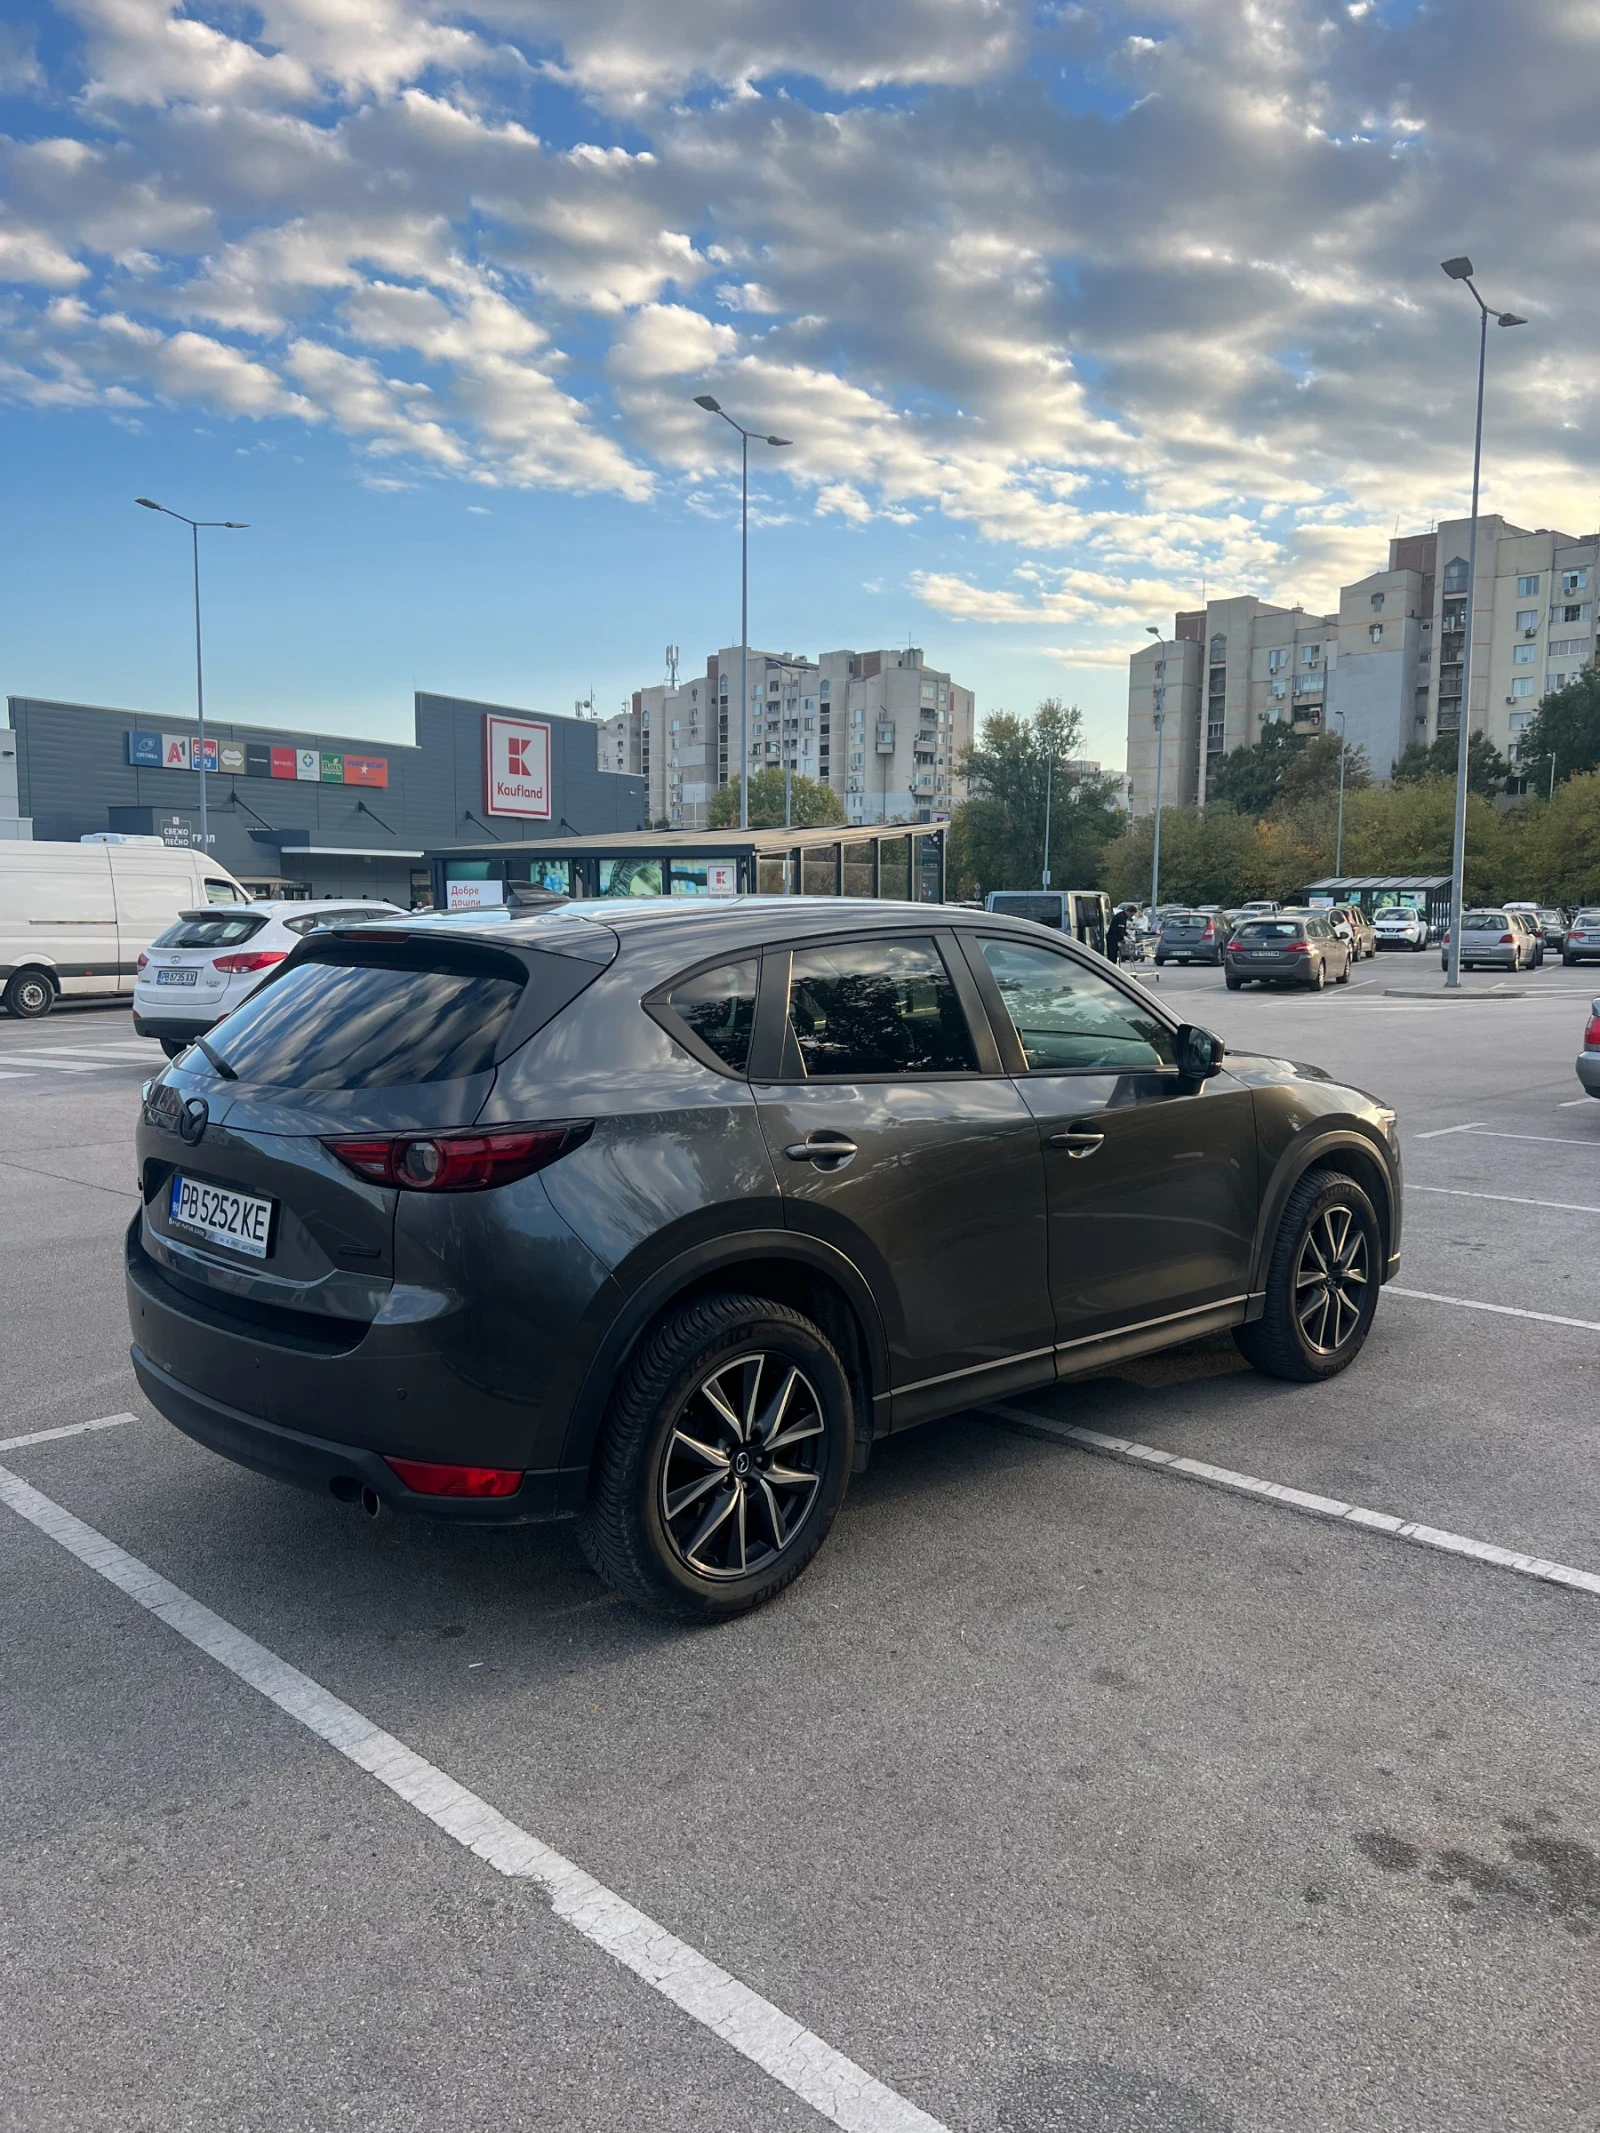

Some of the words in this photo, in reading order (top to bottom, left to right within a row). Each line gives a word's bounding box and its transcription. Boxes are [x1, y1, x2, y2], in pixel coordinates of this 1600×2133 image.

[167, 741, 185, 762] A1
[194, 744, 215, 757] Esy
[194, 756, 211, 767] Py
[497, 782, 542, 799] Kaufland
[164, 828, 189, 836] СВЕЖО
[165, 838, 189, 846] ЛЕСНО
[451, 886, 479, 896] Добре
